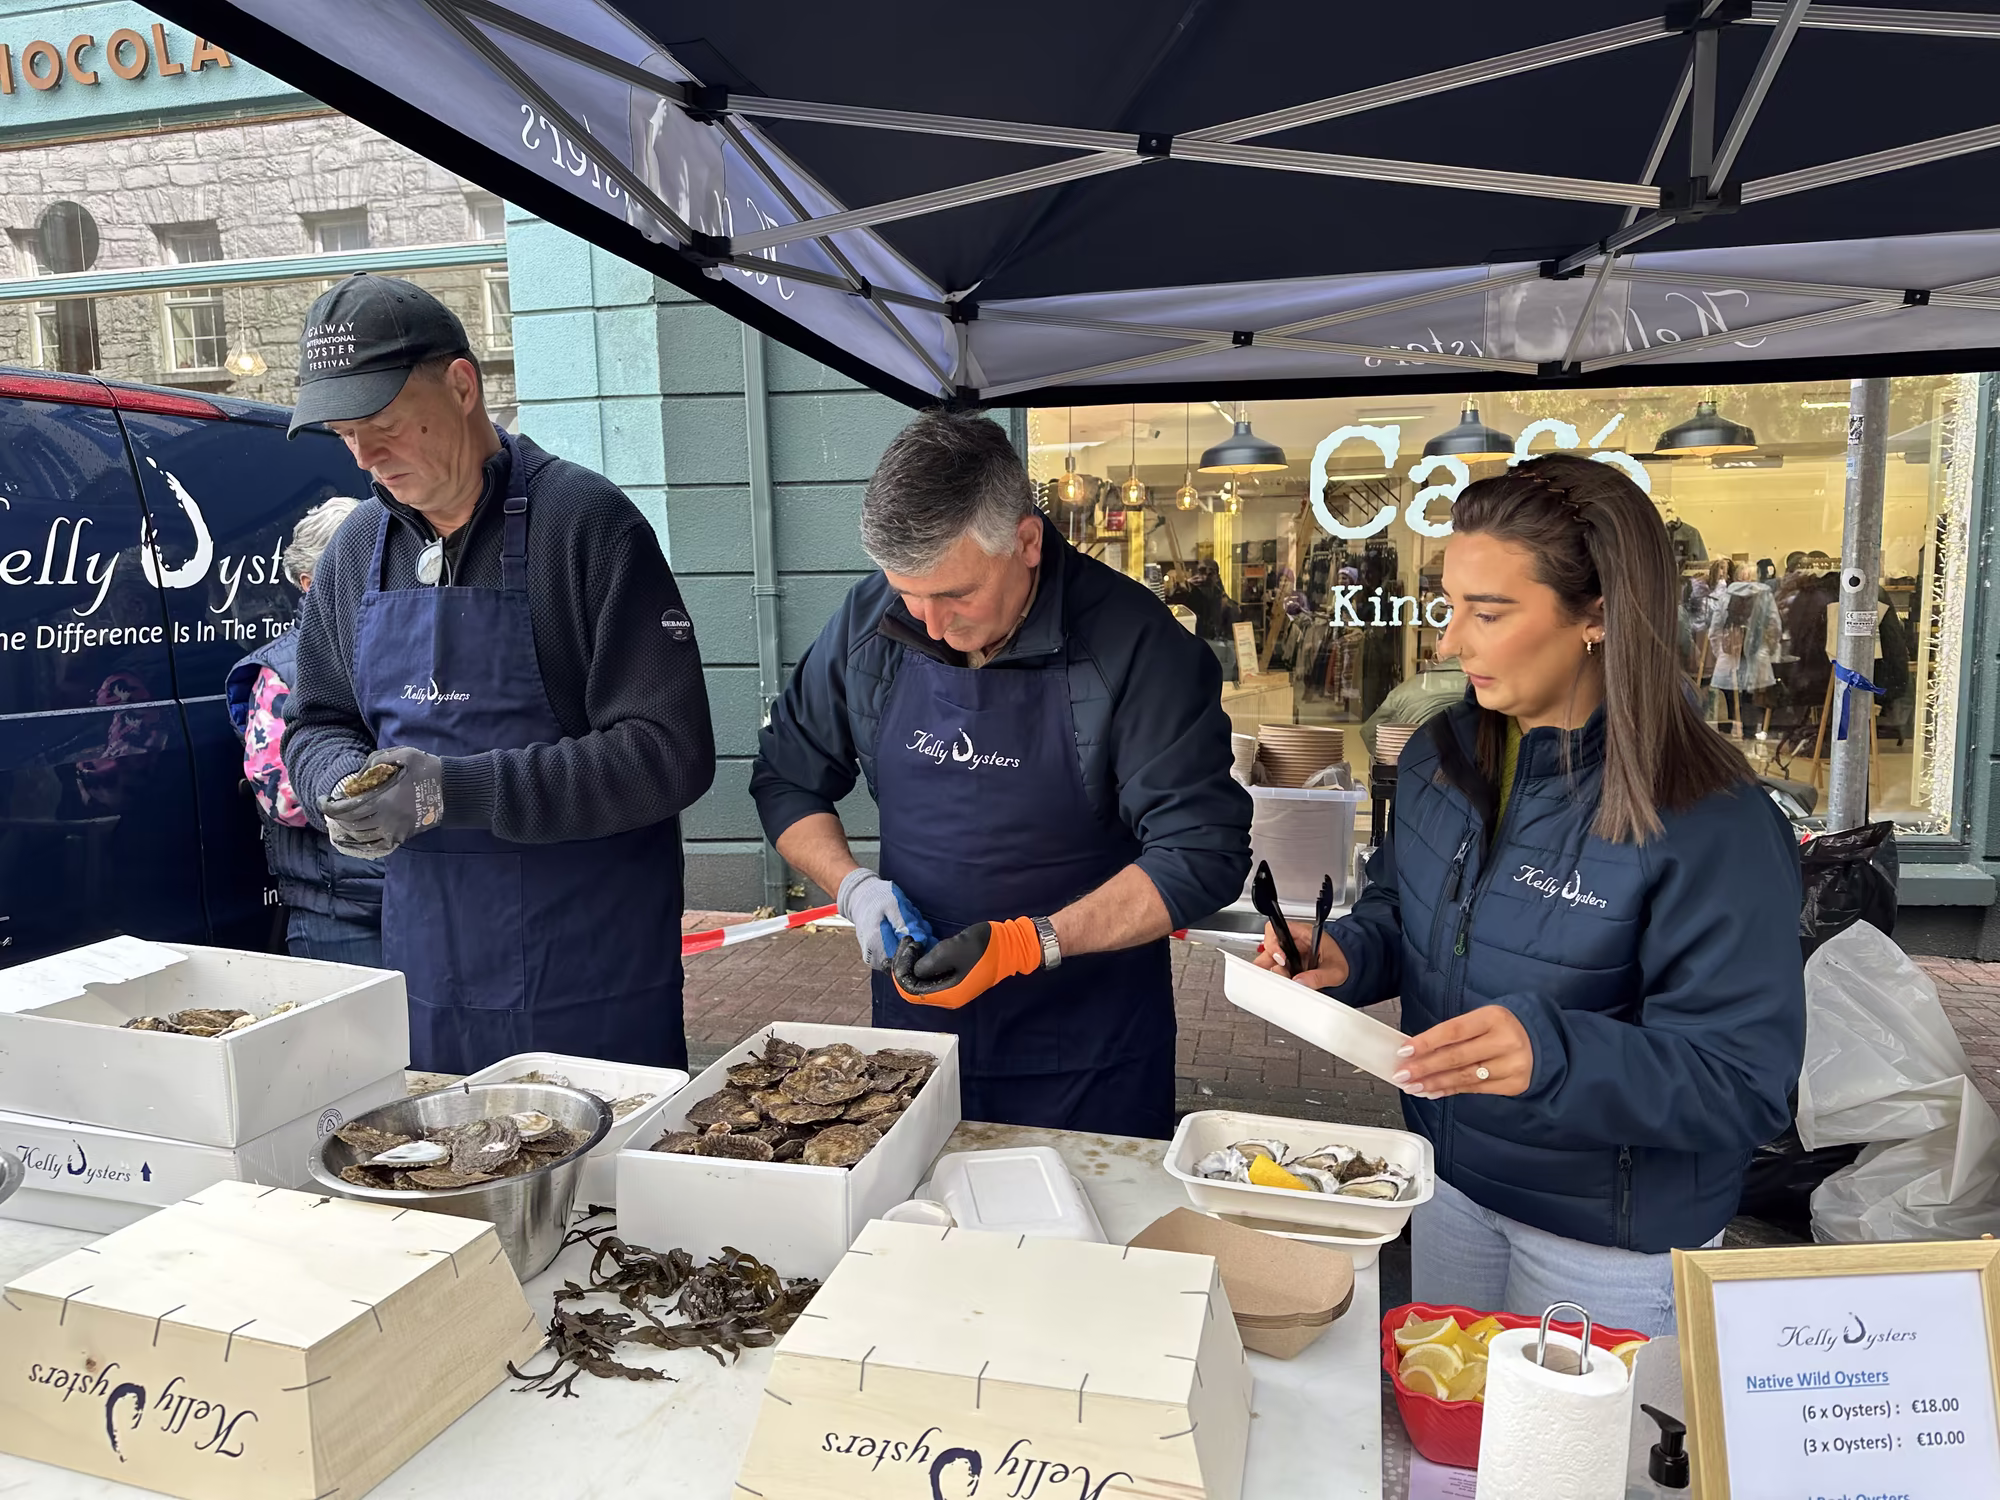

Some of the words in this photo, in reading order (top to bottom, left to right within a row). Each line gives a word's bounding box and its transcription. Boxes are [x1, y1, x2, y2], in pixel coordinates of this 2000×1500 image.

[306, 335, 357, 348] INTERNATIONAL
[308, 322, 354, 338] GALWAY
[307, 344, 355, 360] OYSTER
[309, 358, 351, 371] FESTIVAL
[0, 497, 120, 616] elly
[141, 457, 296, 613] Oyst
[37, 622, 163, 653] Difference
[173, 621, 190, 643] Is
[197, 621, 215, 642] In
[221, 618, 257, 641] The
[661, 620, 690, 628] SEBAGO
[400, 684, 427, 705] Kelly
[906, 729, 949, 765] Kelly
[952, 727, 1021, 770] Oysters
[1513, 865, 1560, 898] Kelly
[1561, 869, 1608, 908] Oysters
[16, 1145, 63, 1179] Kelly
[67, 1139, 131, 1184] Oysters
[1777, 1325, 1838, 1352] Kelly
[1843, 1312, 1918, 1350] Oysters
[1746, 1373, 1794, 1390] Native
[1797, 1371, 1831, 1387] Wild
[1834, 1369, 1889, 1387] Oysters
[153, 1376, 259, 1458] Kelly
[1802, 1404, 1816, 1423] (6
[1820, 1408, 1829, 1419] x
[1911, 1397, 1960, 1413] €18.00
[1803, 1437, 1817, 1456] (3
[1821, 1441, 1830, 1452] x
[1917, 1430, 1966, 1446] €10.00
